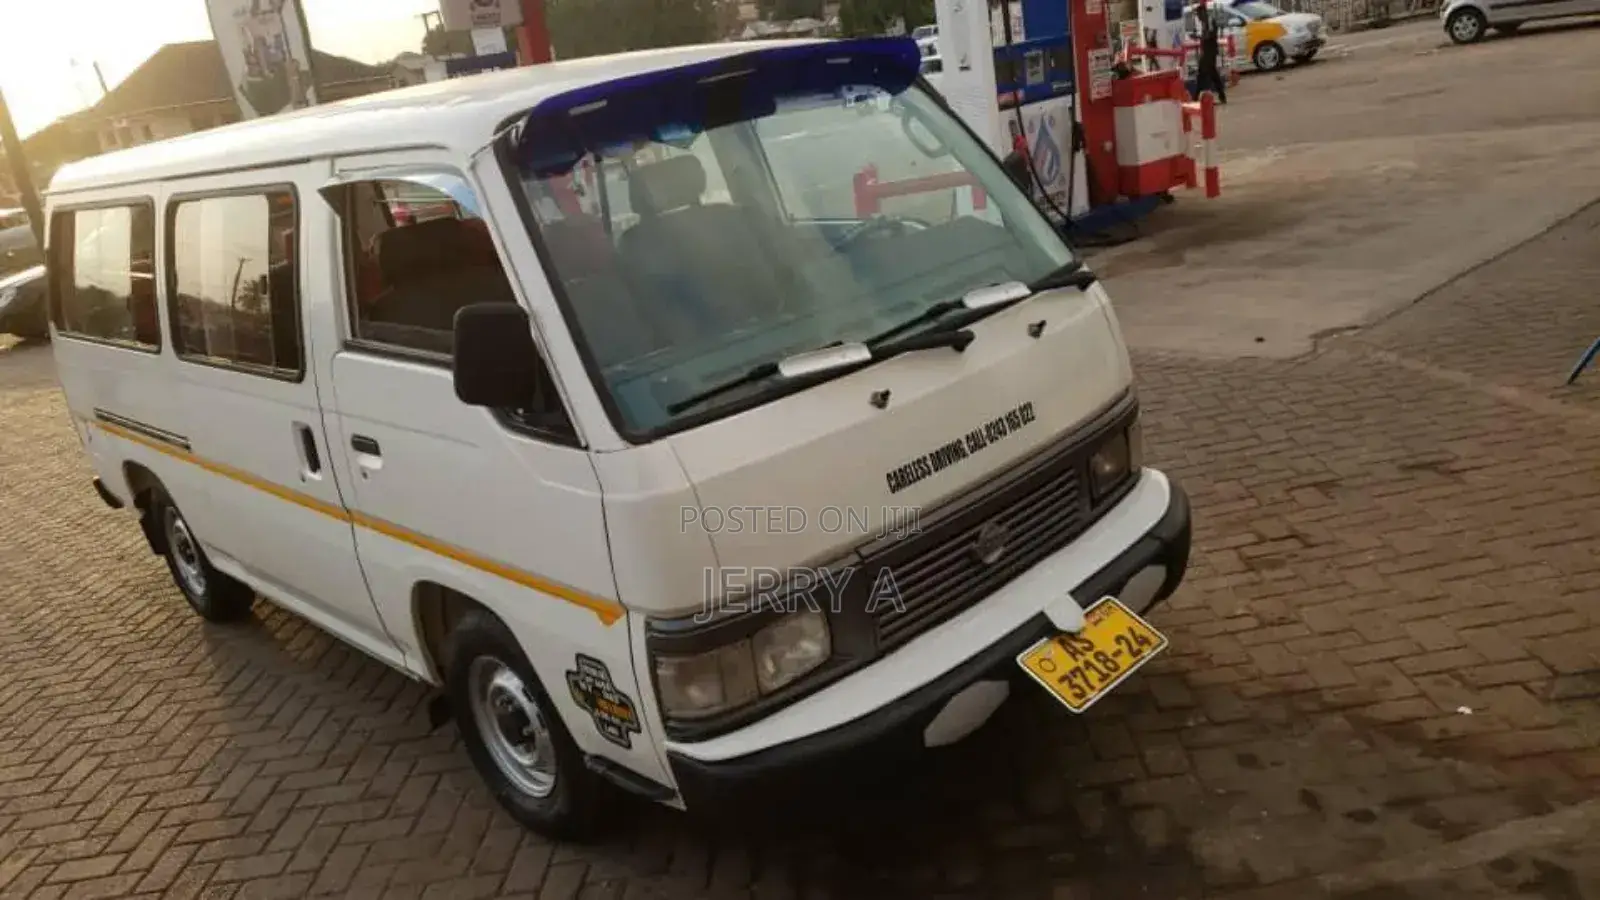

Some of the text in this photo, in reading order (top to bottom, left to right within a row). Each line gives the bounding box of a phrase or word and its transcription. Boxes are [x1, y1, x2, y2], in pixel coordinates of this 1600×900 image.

[886, 455, 932, 494] CARELESS
[1057, 634, 1095, 662] AS
[1057, 626, 1152, 699] 3718-24
